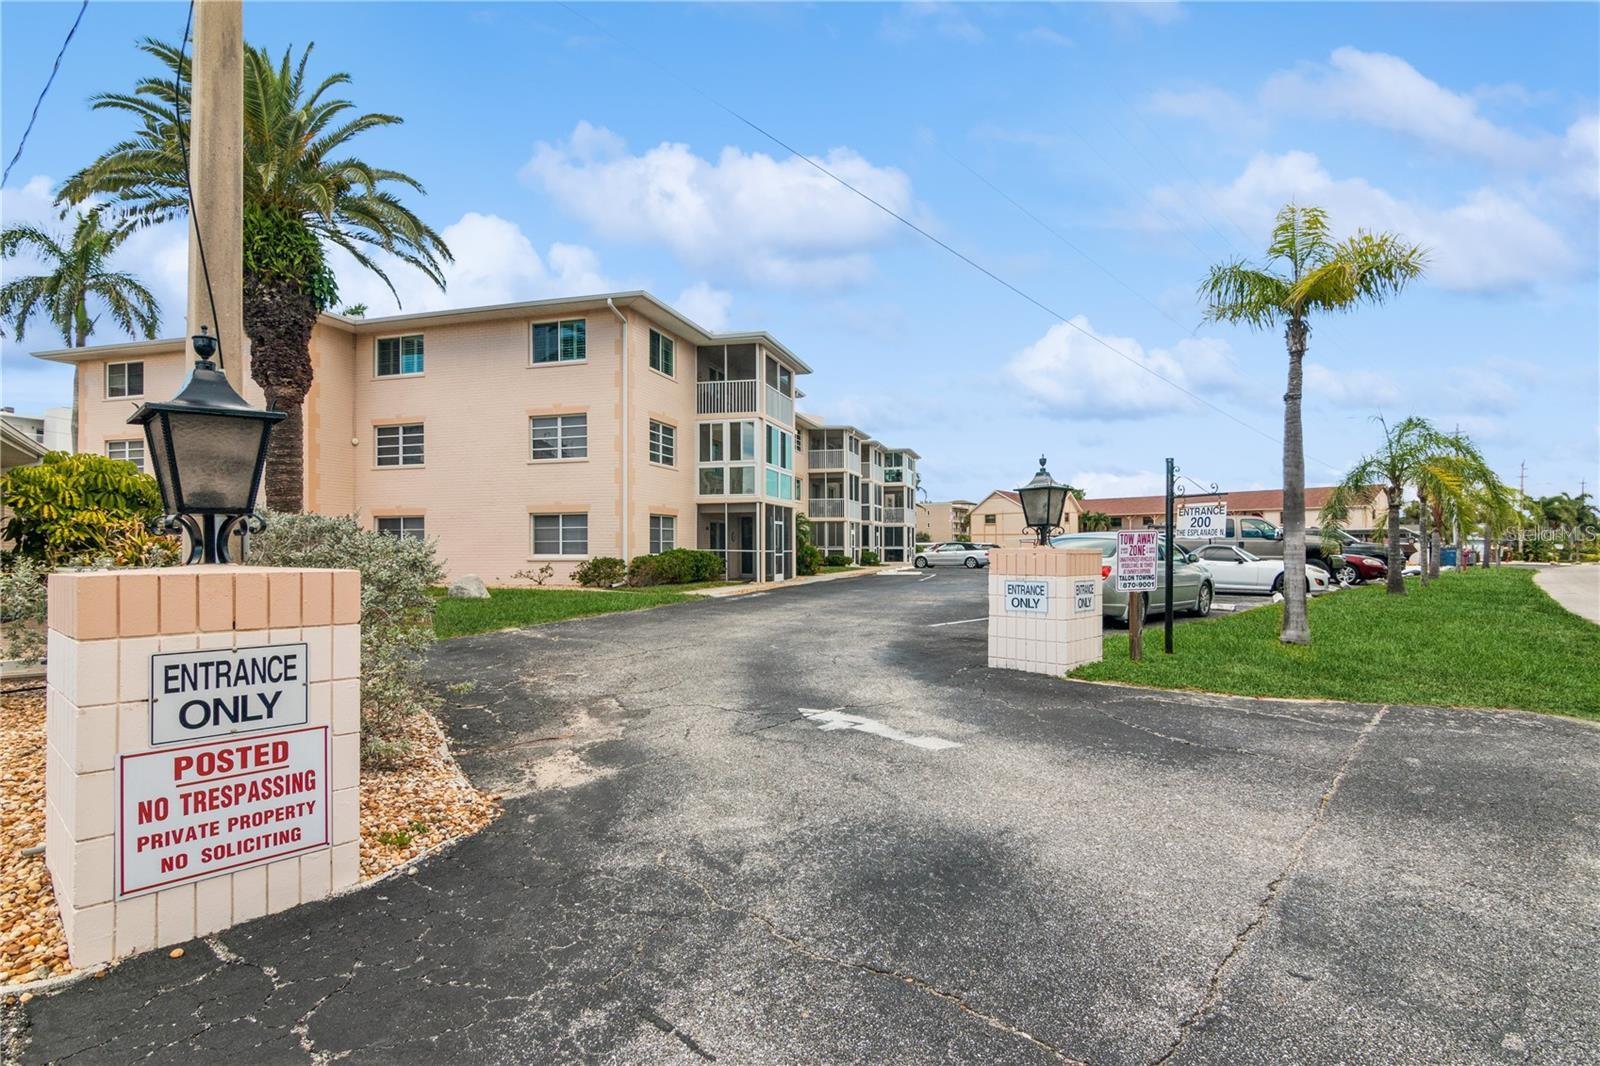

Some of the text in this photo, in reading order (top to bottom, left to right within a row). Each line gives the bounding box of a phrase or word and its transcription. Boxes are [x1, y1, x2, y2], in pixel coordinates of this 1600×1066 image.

[1178, 506, 1225, 517] ENTRANCE
[1190, 516, 1211, 528] 200
[1120, 533, 1155, 545] TOW AWAY
[1187, 529, 1218, 537] ESPLANADE
[1129, 544, 1146, 556] ZONE
[1007, 584, 1045, 596] ENTRANCE
[1075, 584, 1094, 596] ENTRANCE
[1011, 597, 1040, 609] ONLY
[1078, 597, 1092, 609] ONLY
[164, 654, 298, 694] ENTRANCE
[178, 690, 283, 730] ONLY
[173, 740, 290, 781] POSTED
[137, 769, 317, 825] NO TRESPASSING
[137, 800, 317, 853] PRIVATE PROPERTY
[160, 827, 302, 874] NO SOLICITING
